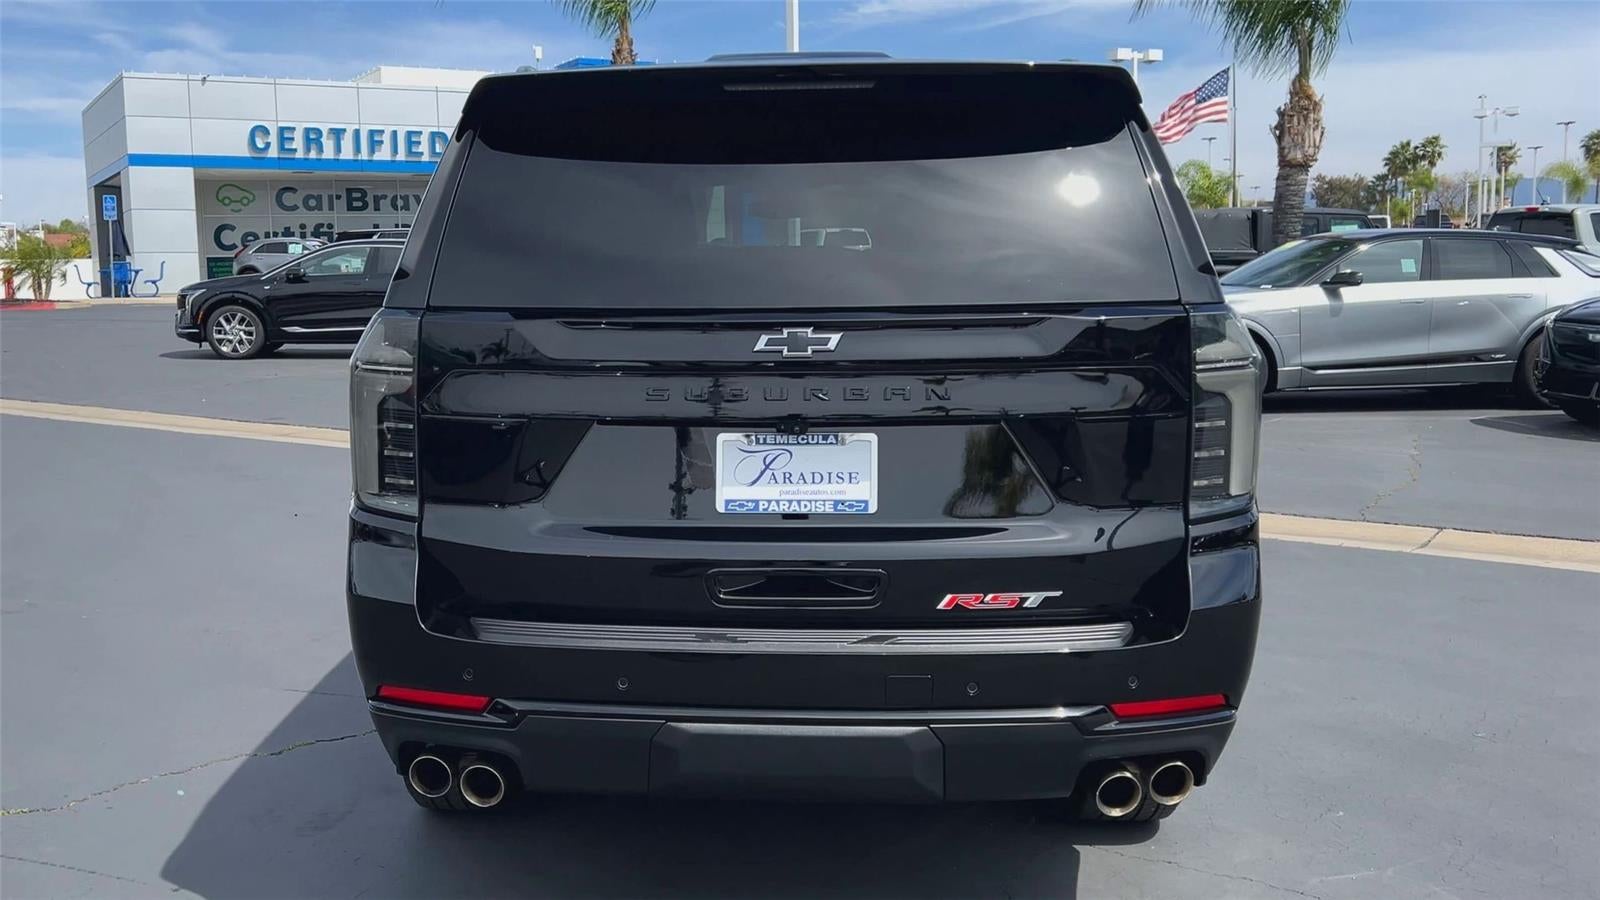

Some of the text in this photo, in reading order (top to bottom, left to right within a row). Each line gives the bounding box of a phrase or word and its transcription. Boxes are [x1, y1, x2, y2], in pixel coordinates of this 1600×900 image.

[248, 124, 449, 158] CERTIFIED
[275, 186, 421, 212] CarBrav
[645, 385, 952, 402] SUBURBAN
[755, 434, 837, 445] TEMECULA
[779, 488, 847, 497] paradiseautos.com
[758, 501, 835, 512] PARADISE
[936, 590, 1064, 610] RST
